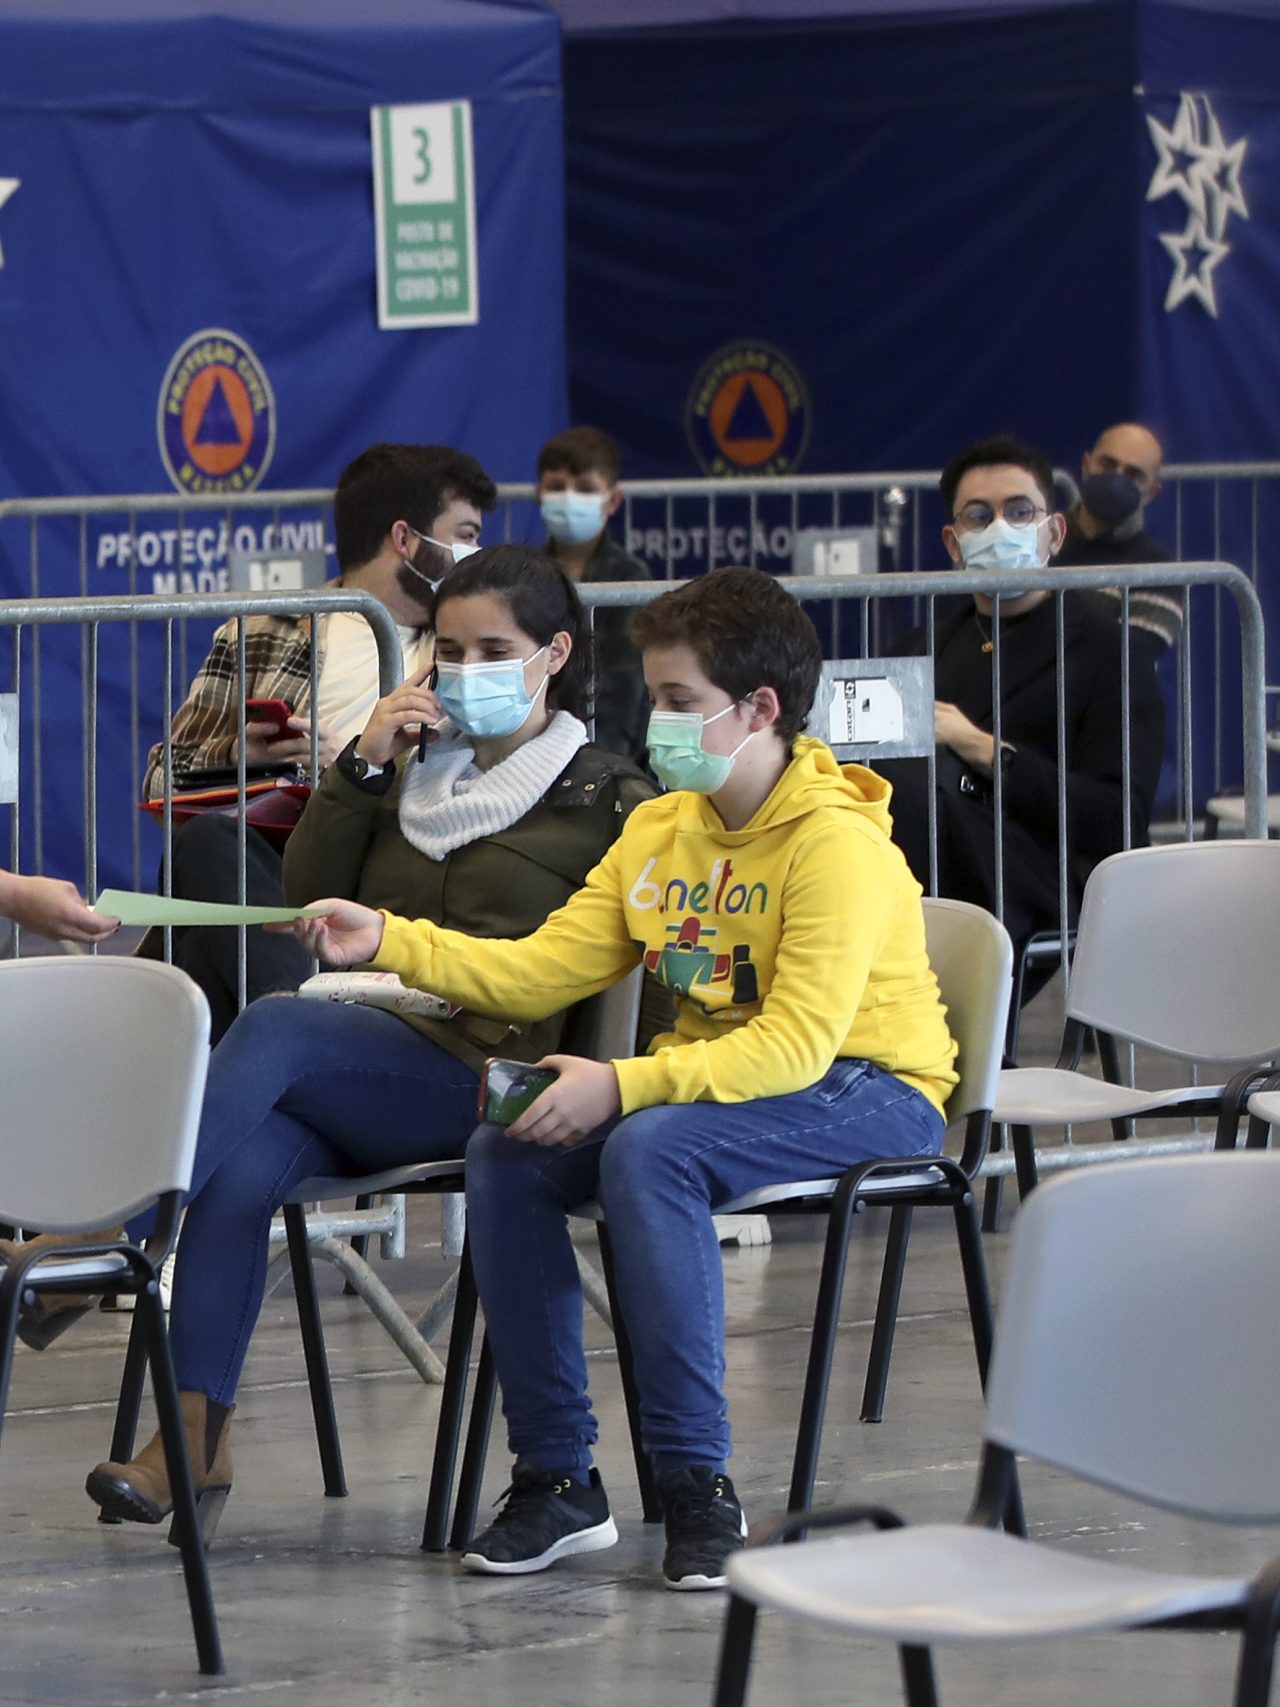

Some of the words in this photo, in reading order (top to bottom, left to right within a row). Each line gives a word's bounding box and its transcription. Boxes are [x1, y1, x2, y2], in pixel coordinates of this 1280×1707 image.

[413, 127, 431, 184] 3
[153, 569, 228, 594] MADE
[629, 857, 768, 914] bnetton
